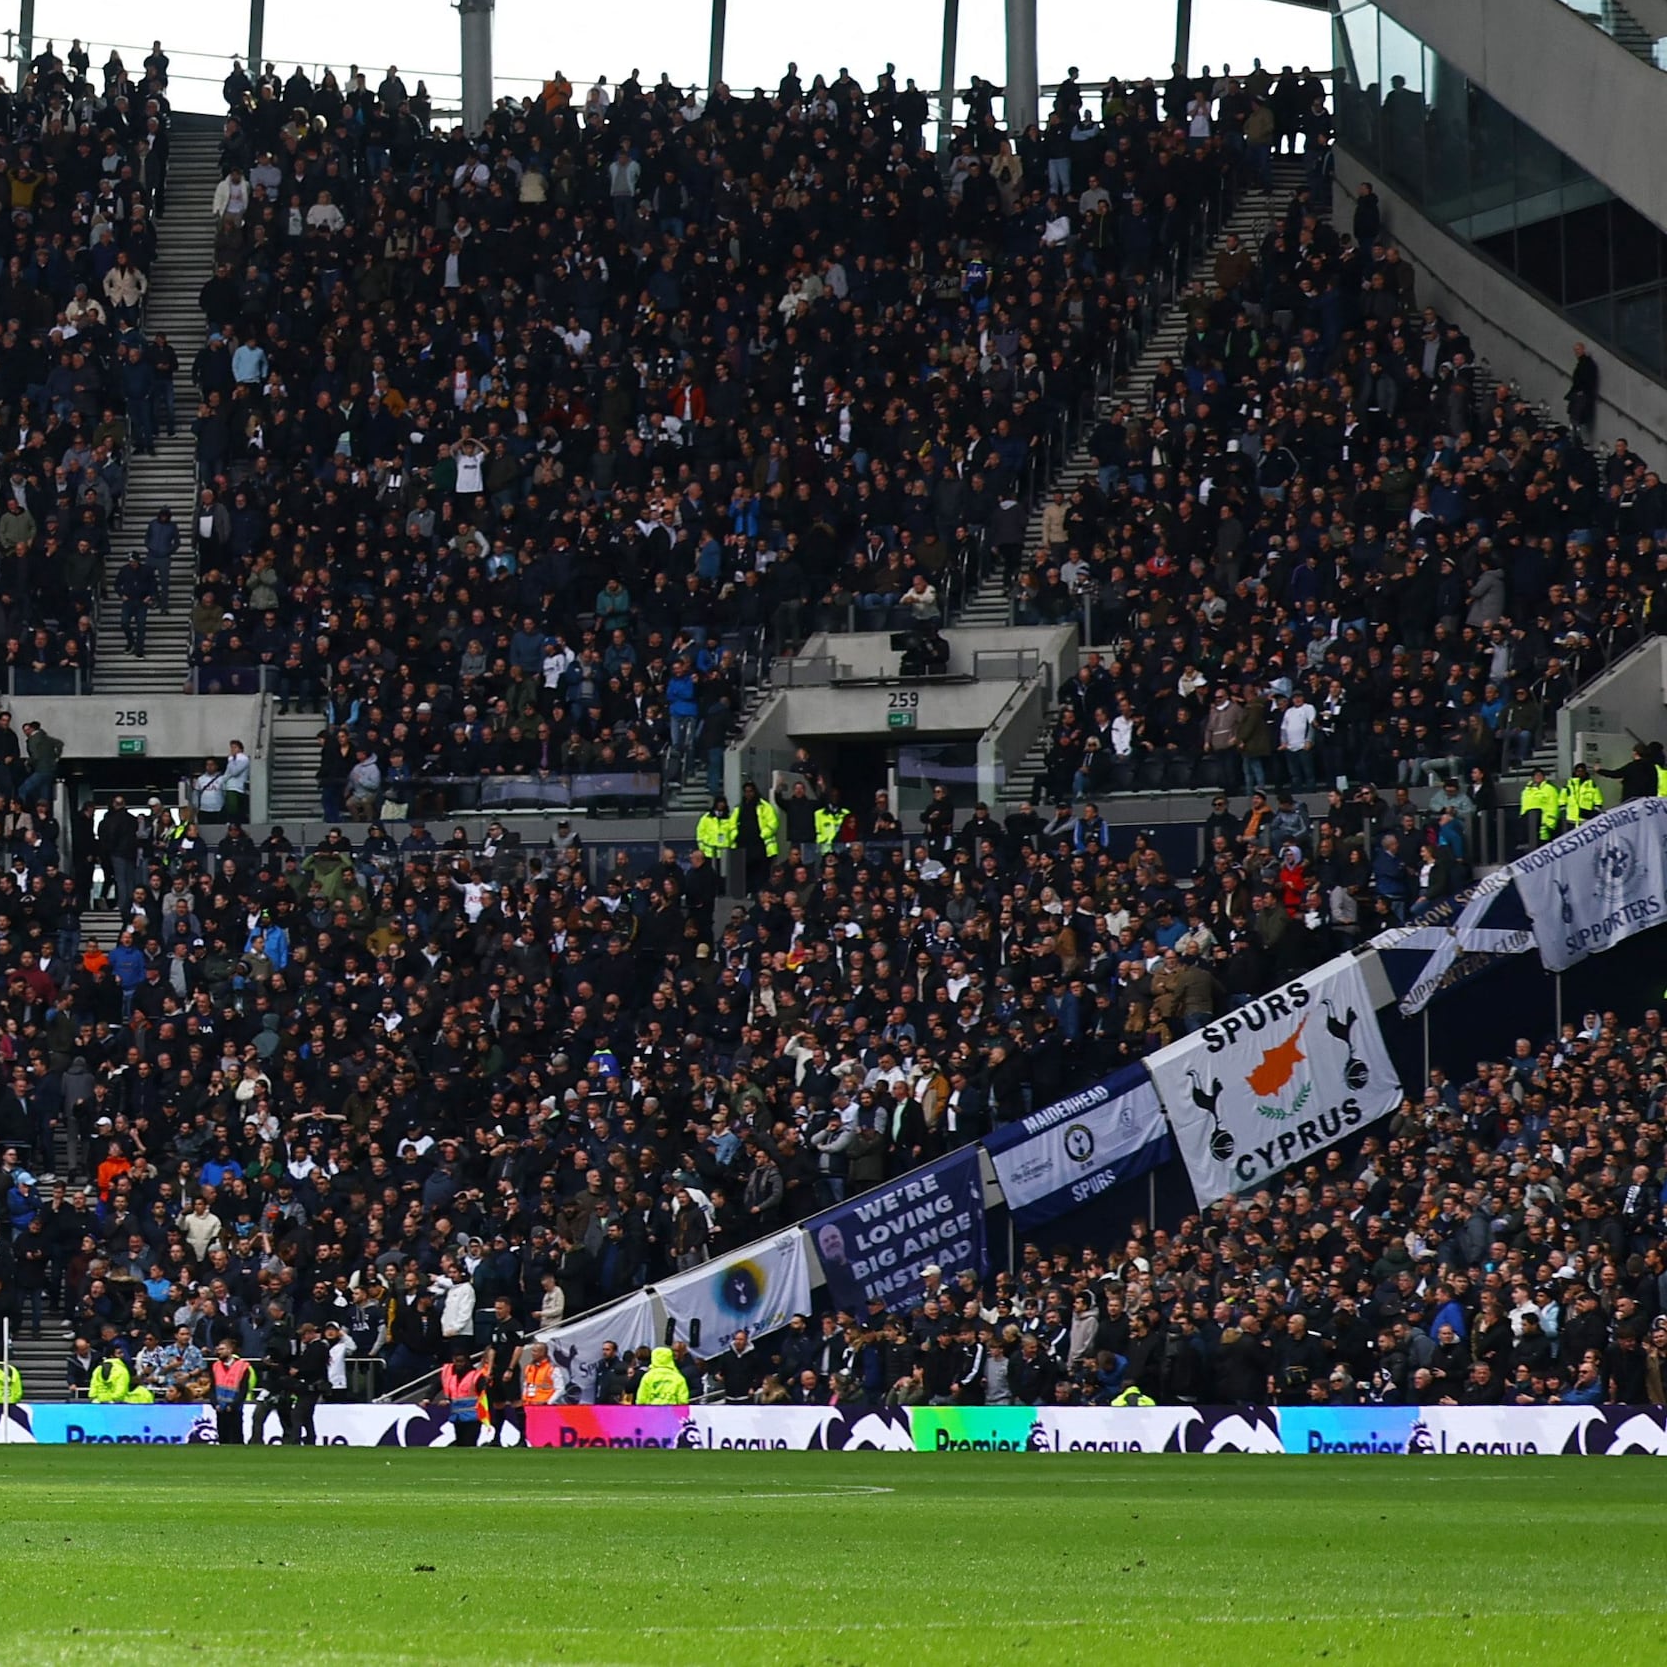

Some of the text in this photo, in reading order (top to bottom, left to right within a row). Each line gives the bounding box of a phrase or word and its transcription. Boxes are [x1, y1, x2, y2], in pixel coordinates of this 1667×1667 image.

[114, 710, 149, 727] 258
[888, 692, 919, 708] 259
[1517, 806, 1640, 875] WORCESTERSHIRE
[1454, 871, 1511, 908] SPURS
[1566, 895, 1660, 956] SUPPORTERS
[1202, 982, 1310, 1053] SPURS
[1022, 1085, 1110, 1135] MAIDENHEAD
[1235, 1098, 1362, 1182] CYPRUS
[853, 1173, 940, 1223] WE'RE
[1071, 1169, 1116, 1202] SPURS
[851, 1212, 972, 1280] BIG ANGE
[855, 1194, 954, 1251] LOVING
